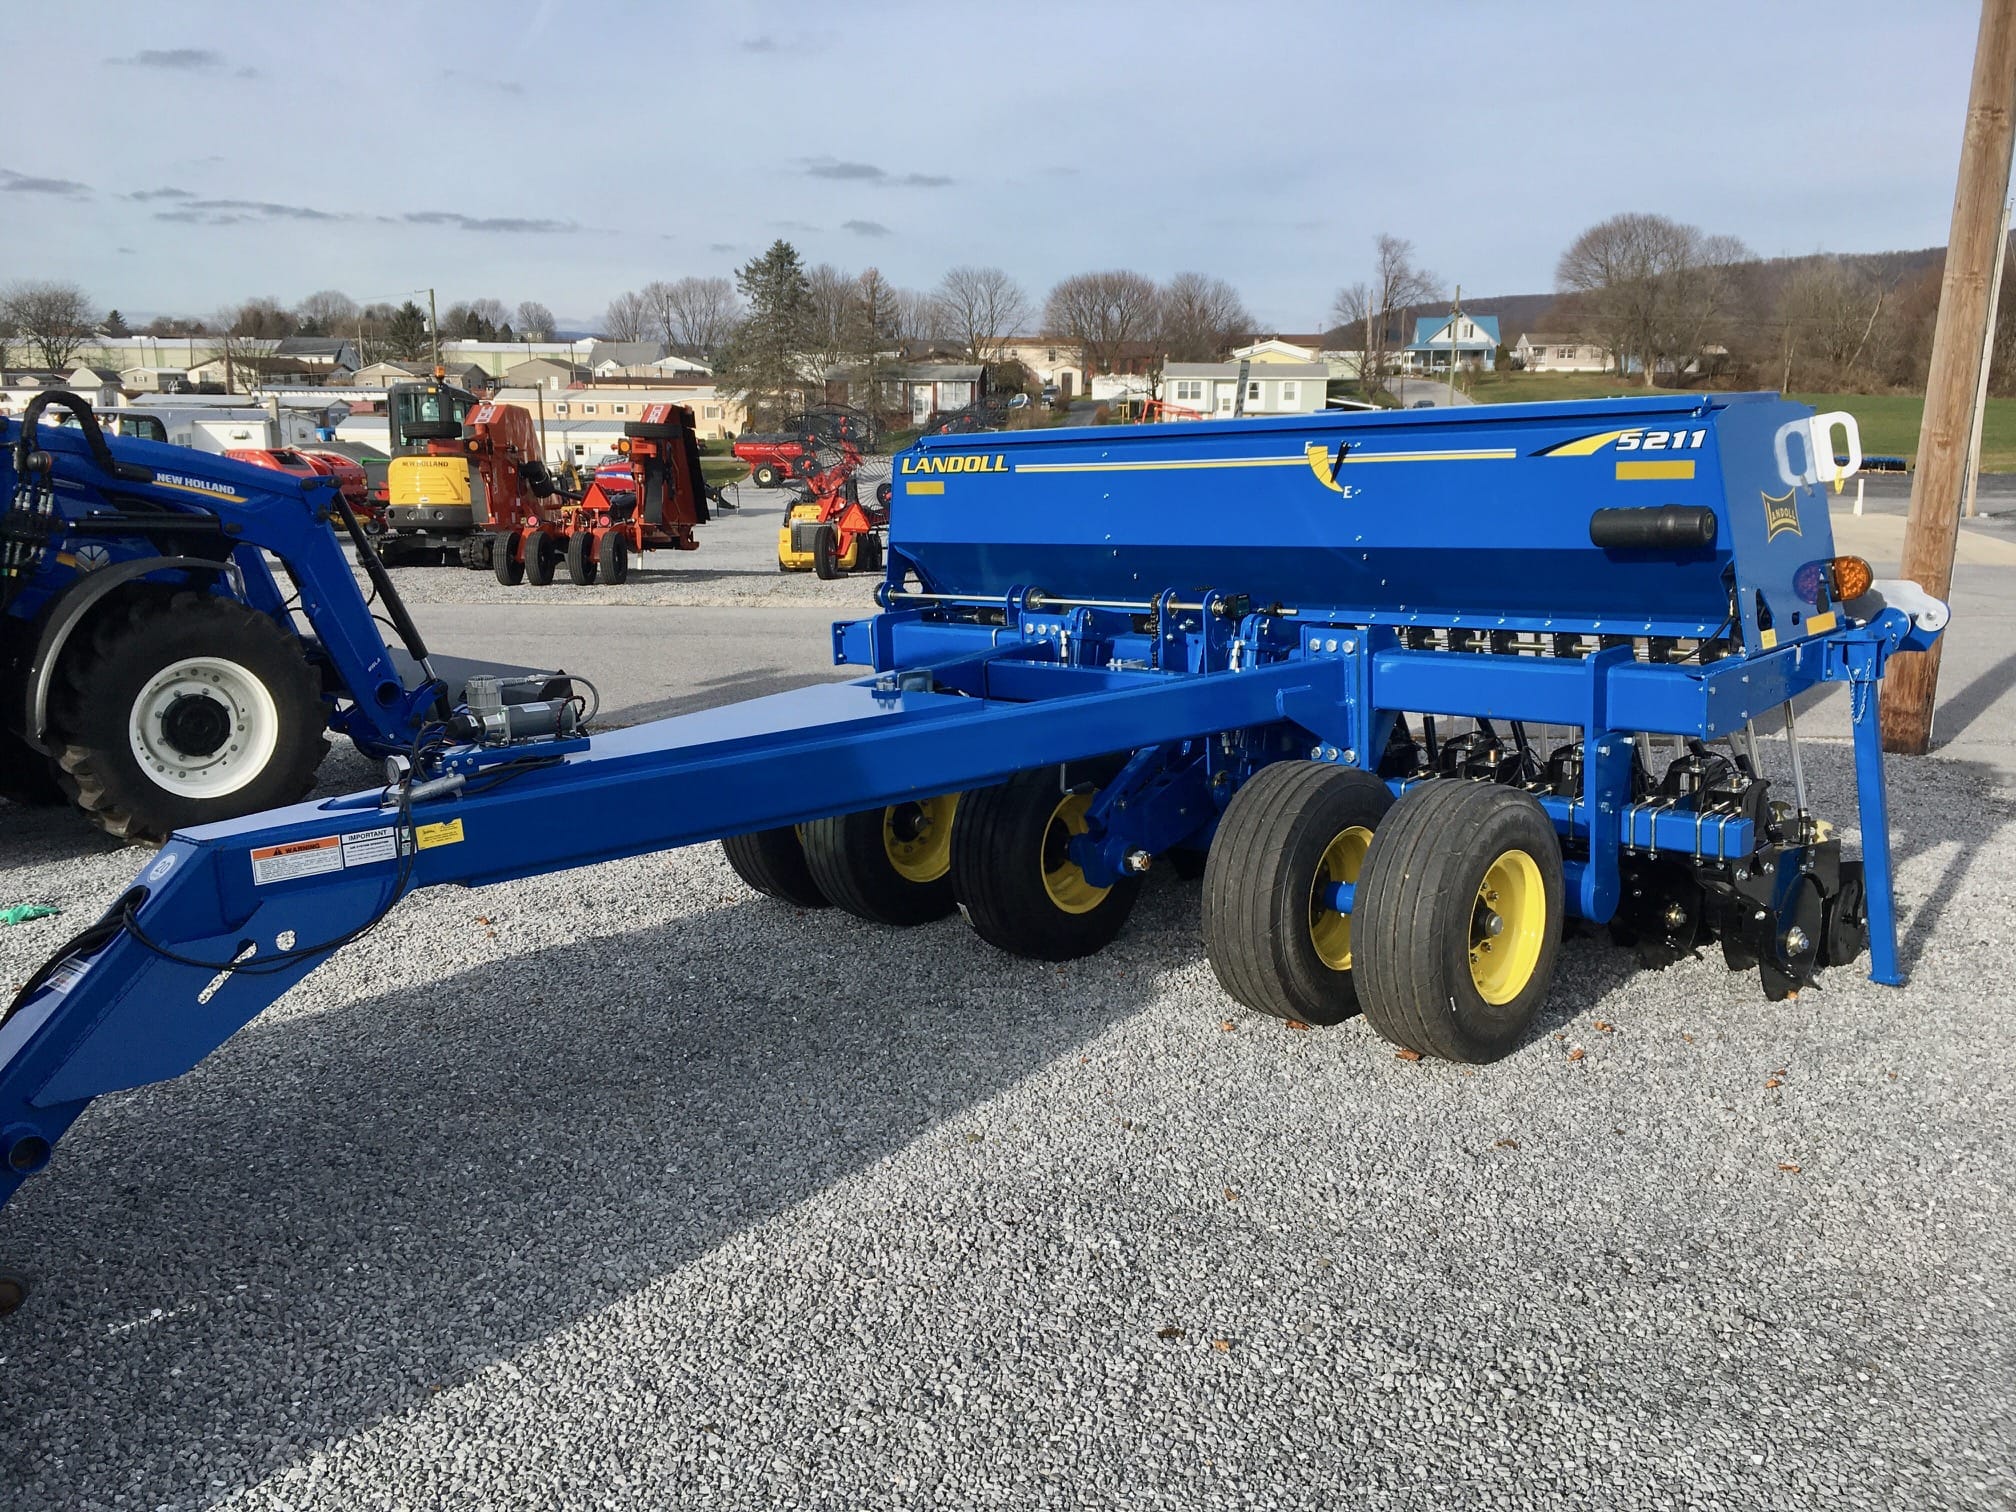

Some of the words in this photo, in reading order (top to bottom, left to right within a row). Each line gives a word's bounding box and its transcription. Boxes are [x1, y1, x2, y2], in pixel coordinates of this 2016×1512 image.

[1615, 429, 1705, 451] 5211
[901, 455, 1009, 474] LANDOLL
[156, 473, 182, 485] NEW
[185, 477, 235, 494] HOLLAND
[1343, 486, 1353, 499] E
[348, 830, 387, 841] IMPORTANT
[285, 842, 321, 854] WARNING
[154, 860, 172, 874] 20
